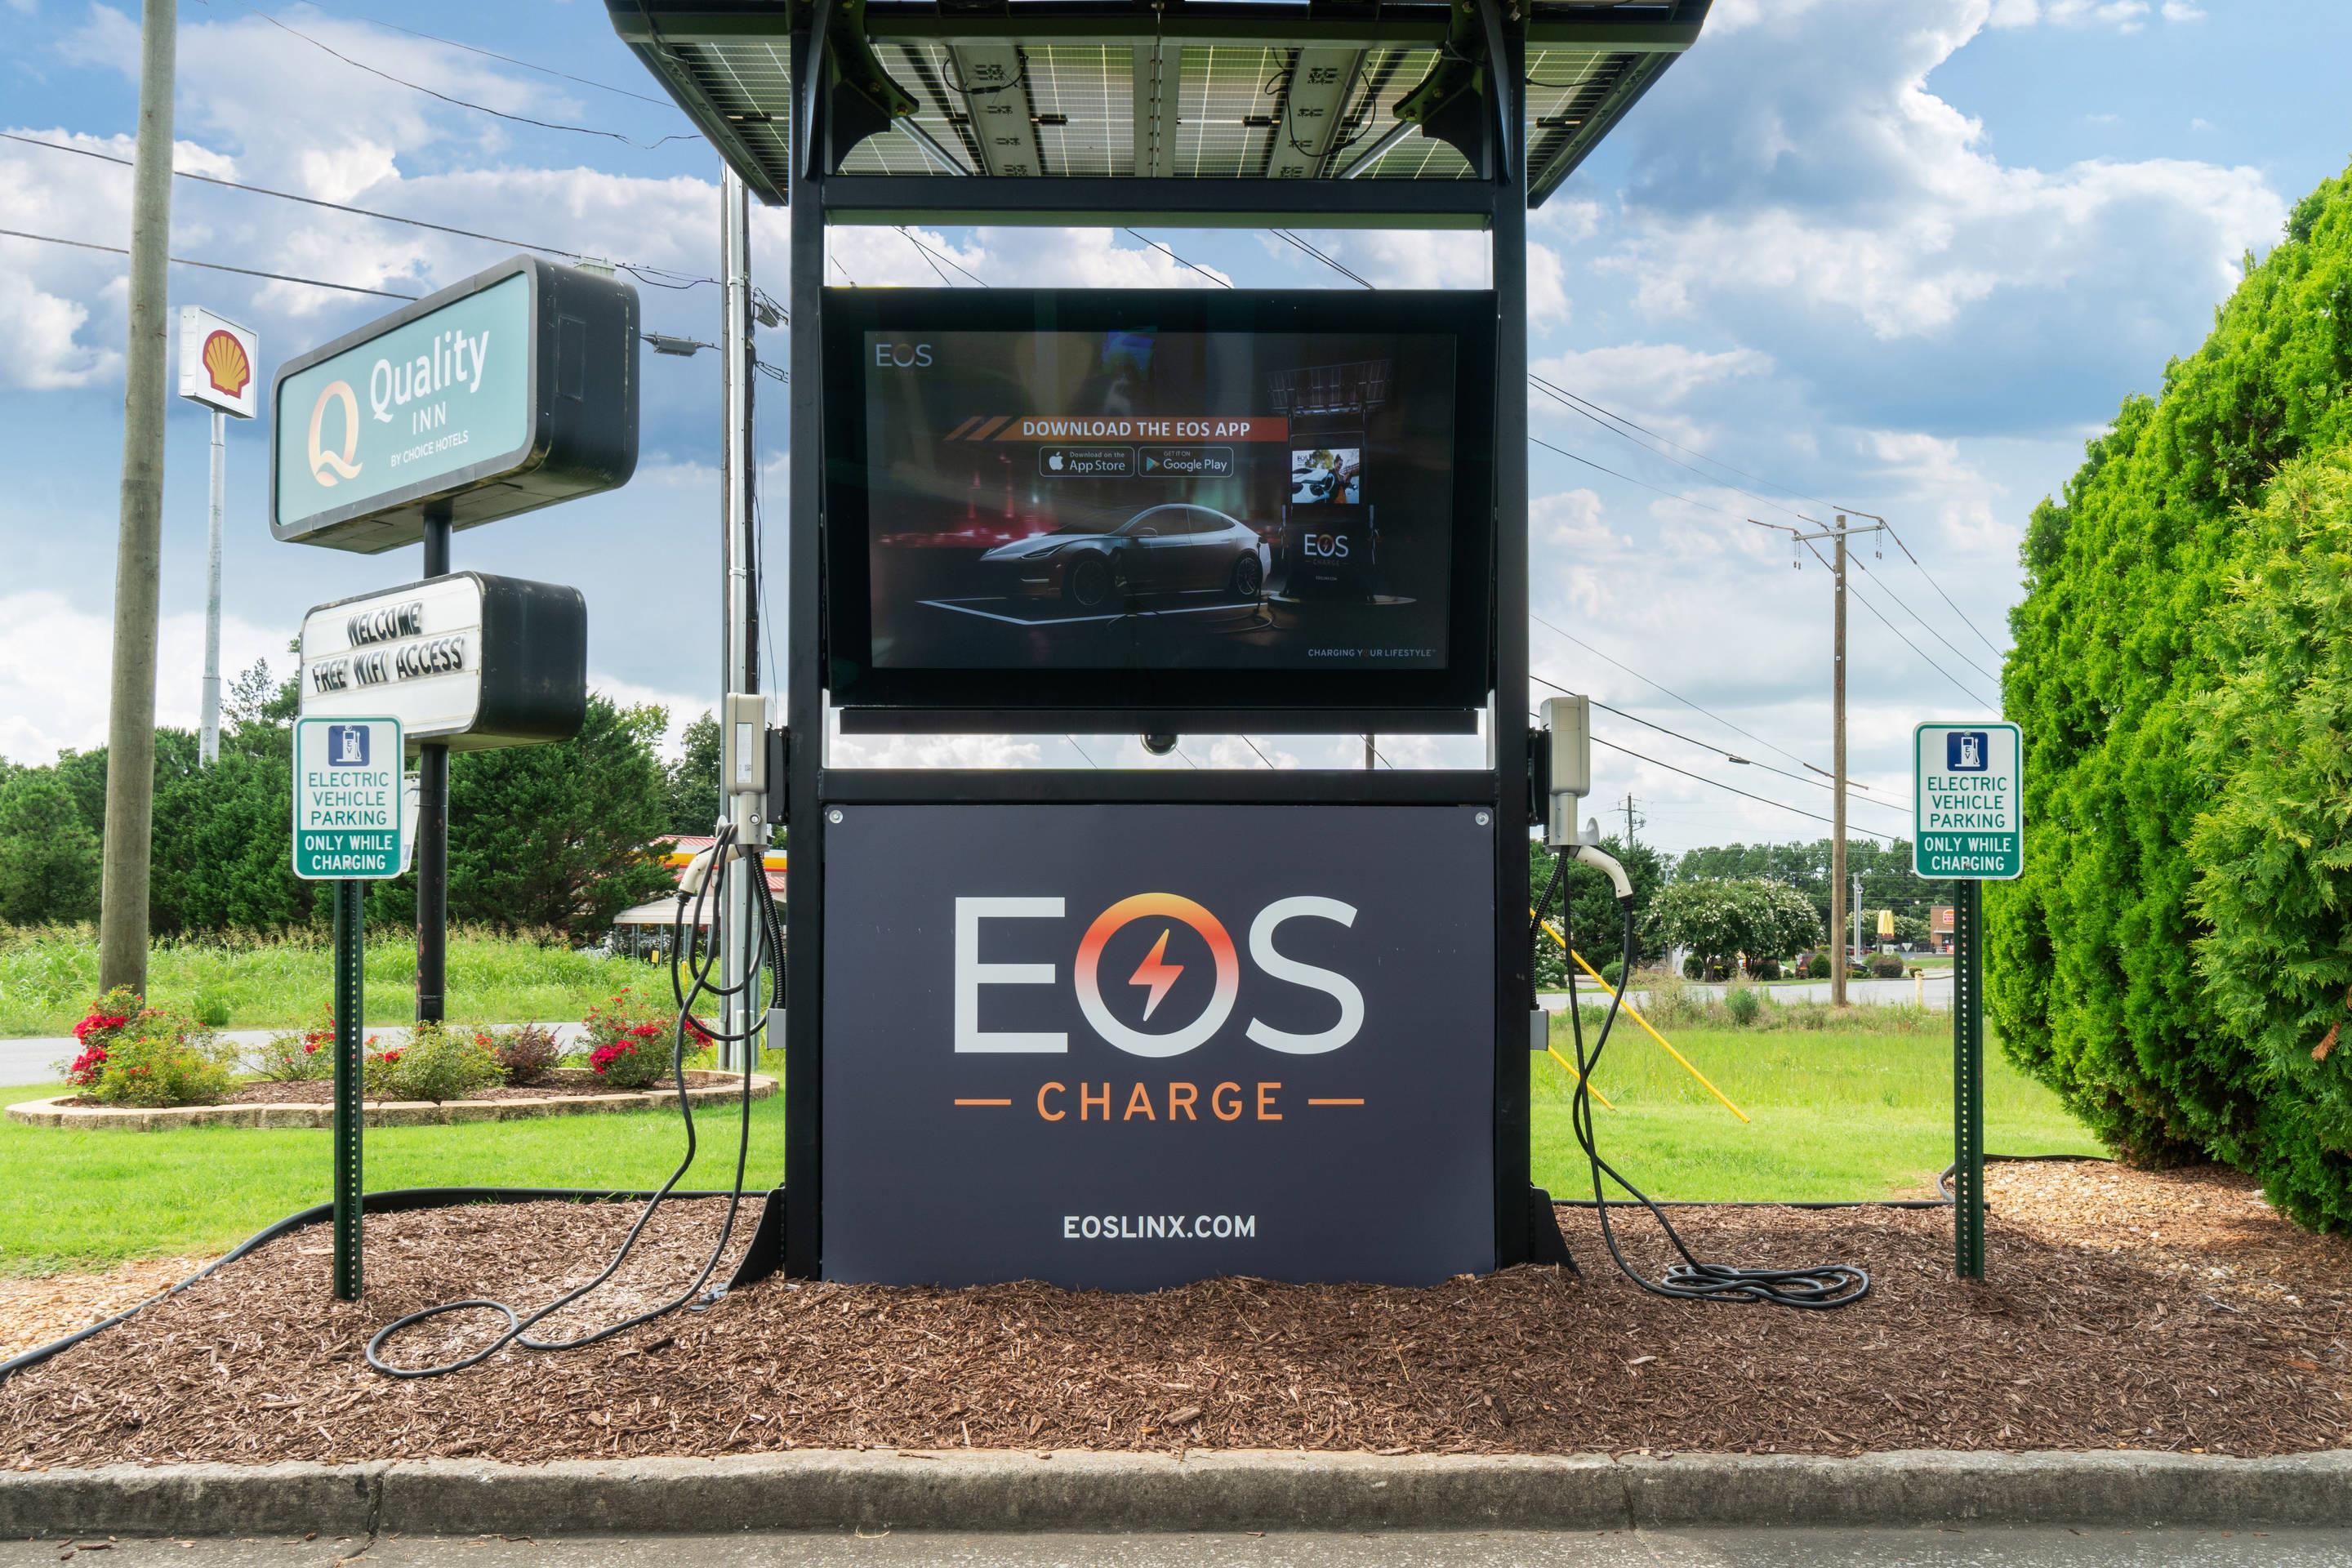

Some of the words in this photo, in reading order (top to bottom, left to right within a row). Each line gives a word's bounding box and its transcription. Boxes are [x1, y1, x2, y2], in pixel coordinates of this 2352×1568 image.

[875, 343, 933, 367] EOS
[370, 330, 489, 423] Quality
[412, 401, 446, 435] INN
[1022, 421, 1131, 437] DOWNLOAD
[1136, 421, 1170, 437] THE
[1176, 421, 1210, 437] EOS
[1214, 421, 1250, 437] APP
[390, 454, 402, 467] BY
[403, 442, 434, 463] CHOICE
[435, 430, 469, 452] HOTELS
[1069, 460, 1094, 473] App
[1095, 460, 1125, 471] Store
[1163, 458, 1202, 472] Google
[1204, 458, 1227, 472] Play
[1304, 533, 1348, 558] EOS
[346, 600, 422, 647] WELCOME
[1307, 648, 1355, 657] CHARGING
[312, 658, 348, 693] FREE
[353, 649, 389, 685] WIFI
[395, 636, 465, 679] ACCESS
[308, 772, 390, 787] ELECTRIC
[1927, 777, 2007, 791] ELECTRIC
[313, 791, 386, 807] VEHICLE
[1932, 795, 2004, 809] VEHICLE
[311, 810, 387, 826] PARKING
[1930, 813, 2006, 828] PARKING
[305, 835, 343, 851] ONLY
[350, 835, 393, 850] WHILE
[1924, 836, 1962, 852] ONLY
[1967, 837, 2012, 853] WHILE
[312, 854, 385, 871] CHARGING
[1931, 856, 2005, 871] CHARGING
[954, 892, 1365, 1058] EOS
[1036, 1081, 1283, 1121] CHARGE
[1063, 1214, 1256, 1239] EOSLINX.COM
